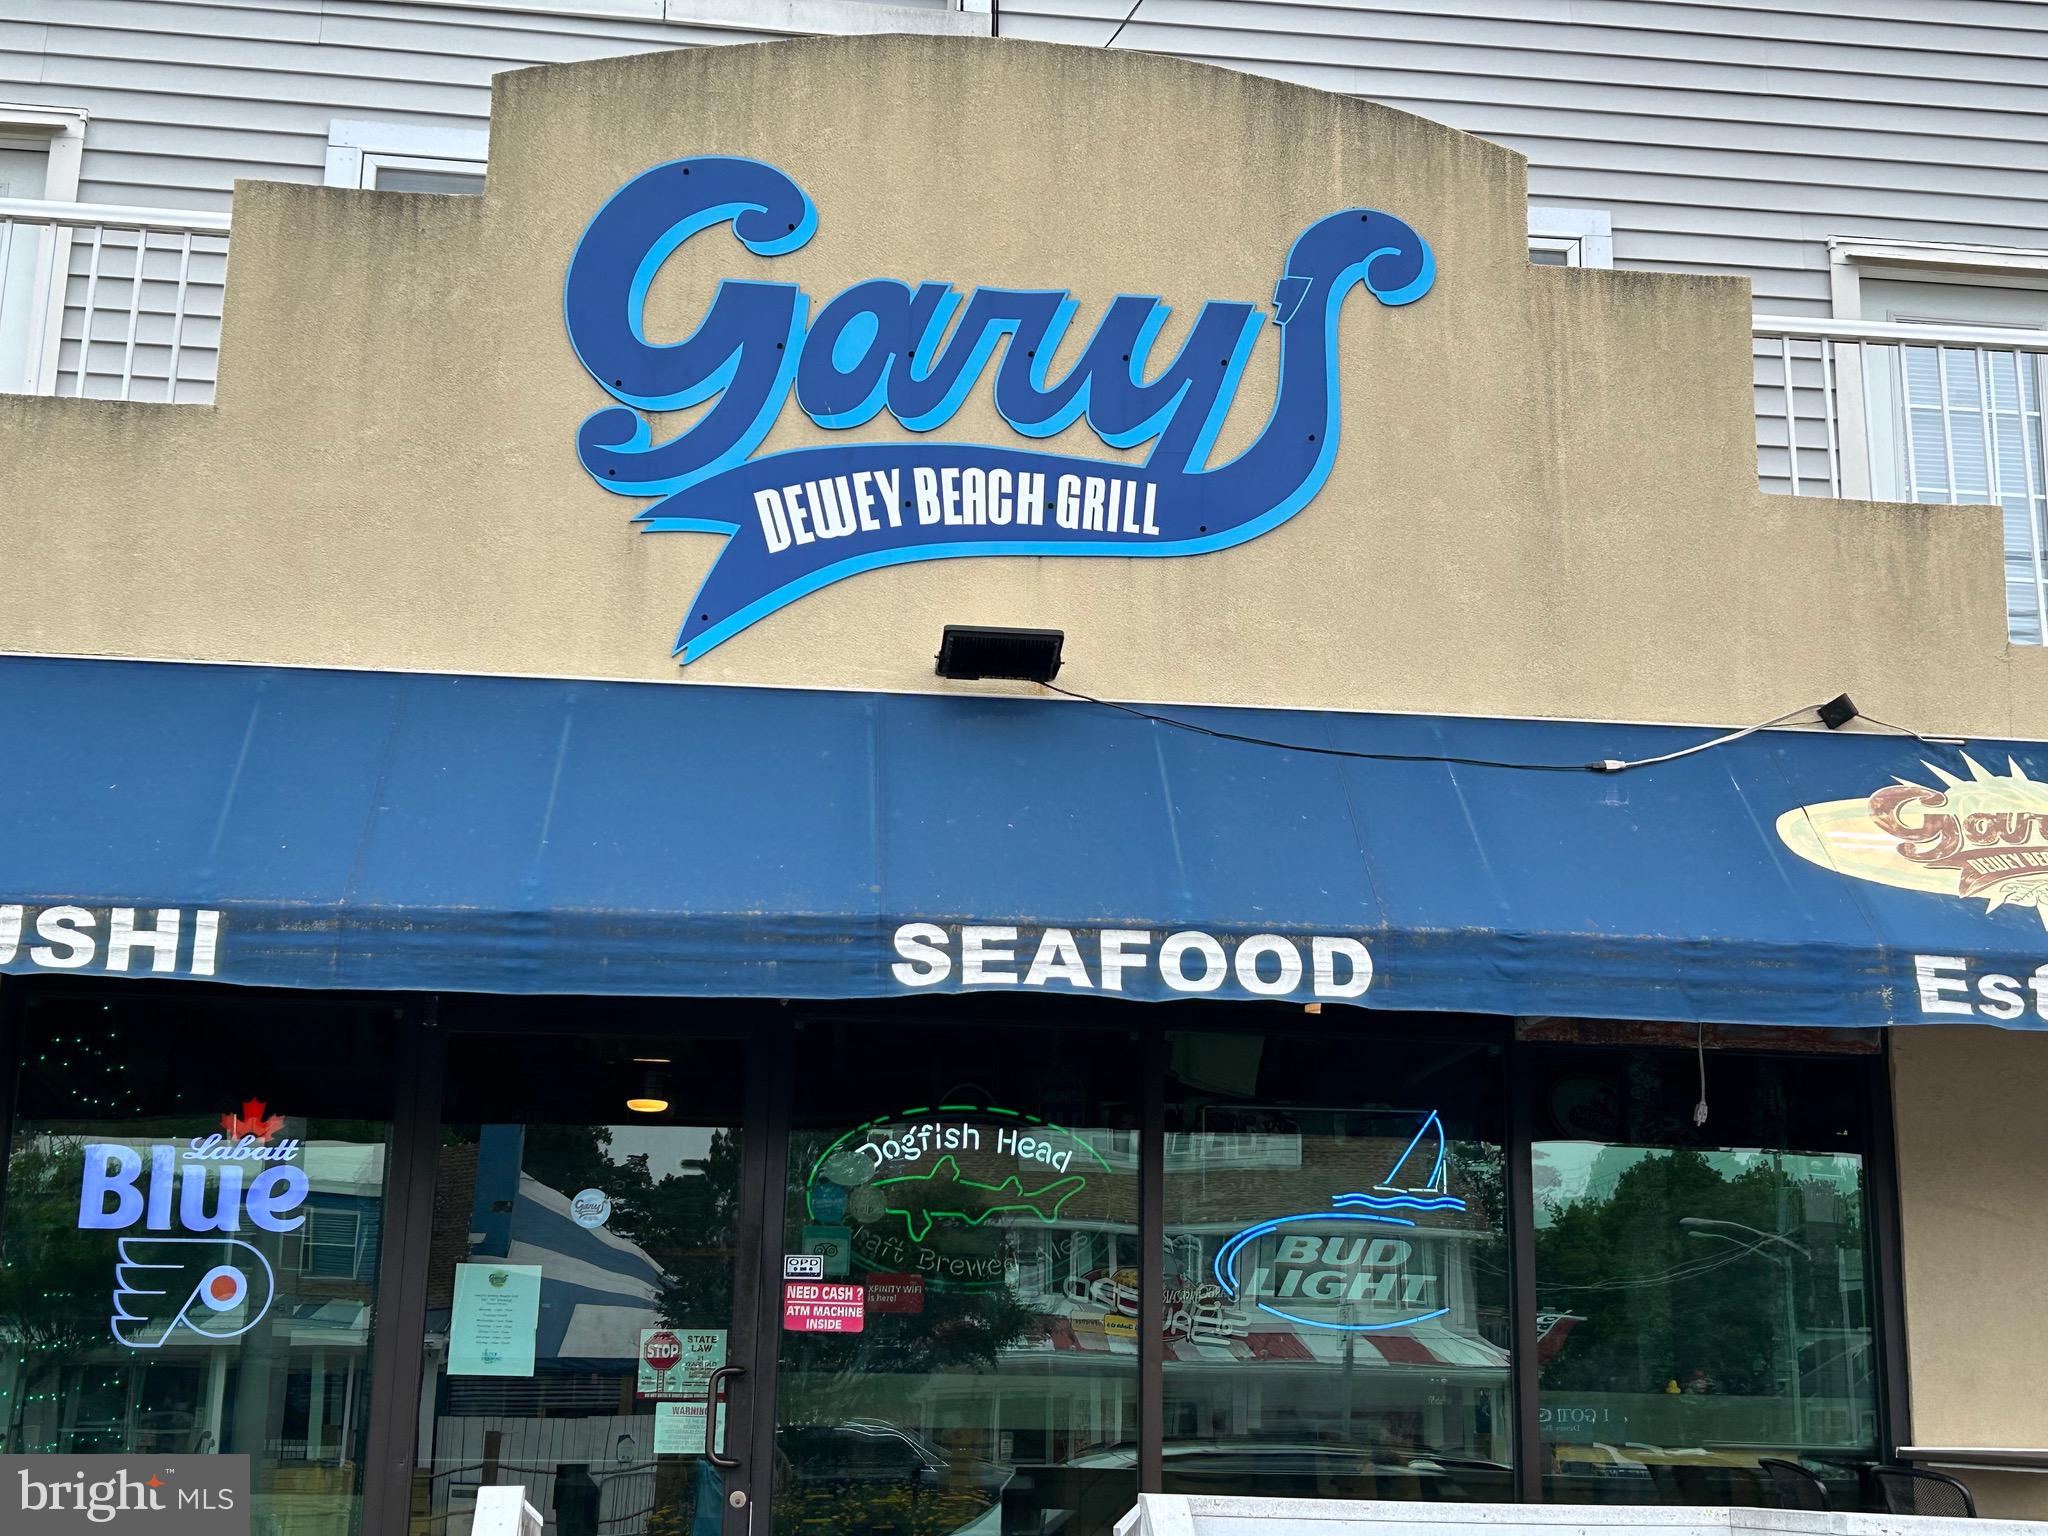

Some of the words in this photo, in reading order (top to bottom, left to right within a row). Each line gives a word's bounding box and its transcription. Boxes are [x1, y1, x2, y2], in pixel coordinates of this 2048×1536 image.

[753, 468, 902, 554] DEWEY
[914, 467, 1045, 525] BEACH
[1056, 475, 1160, 535] GRILL
[1967, 853, 2026, 874] DEWEY
[891, 923, 1373, 998] SEAFOOD
[183, 1133, 300, 1160] Labatt
[997, 1128, 1072, 1173] Head
[78, 1143, 309, 1232] Blue
[915, 1248, 1019, 1277] Brewed
[1274, 1236, 1411, 1266] BUD
[787, 1286, 818, 1299] NEED
[822, 1287, 853, 1300] CASH
[857, 1288, 864, 1300] ?
[868, 1285, 900, 1293] XFINITY
[1245, 1268, 1437, 1302] LIGHT
[787, 1305, 810, 1316] ATM
[813, 1306, 863, 1317] MACHINE
[806, 1319, 842, 1330] INSIDE
[647, 1344, 679, 1358] STOP
[688, 1336, 717, 1344] STATE
[691, 1344, 712, 1352] LAW
